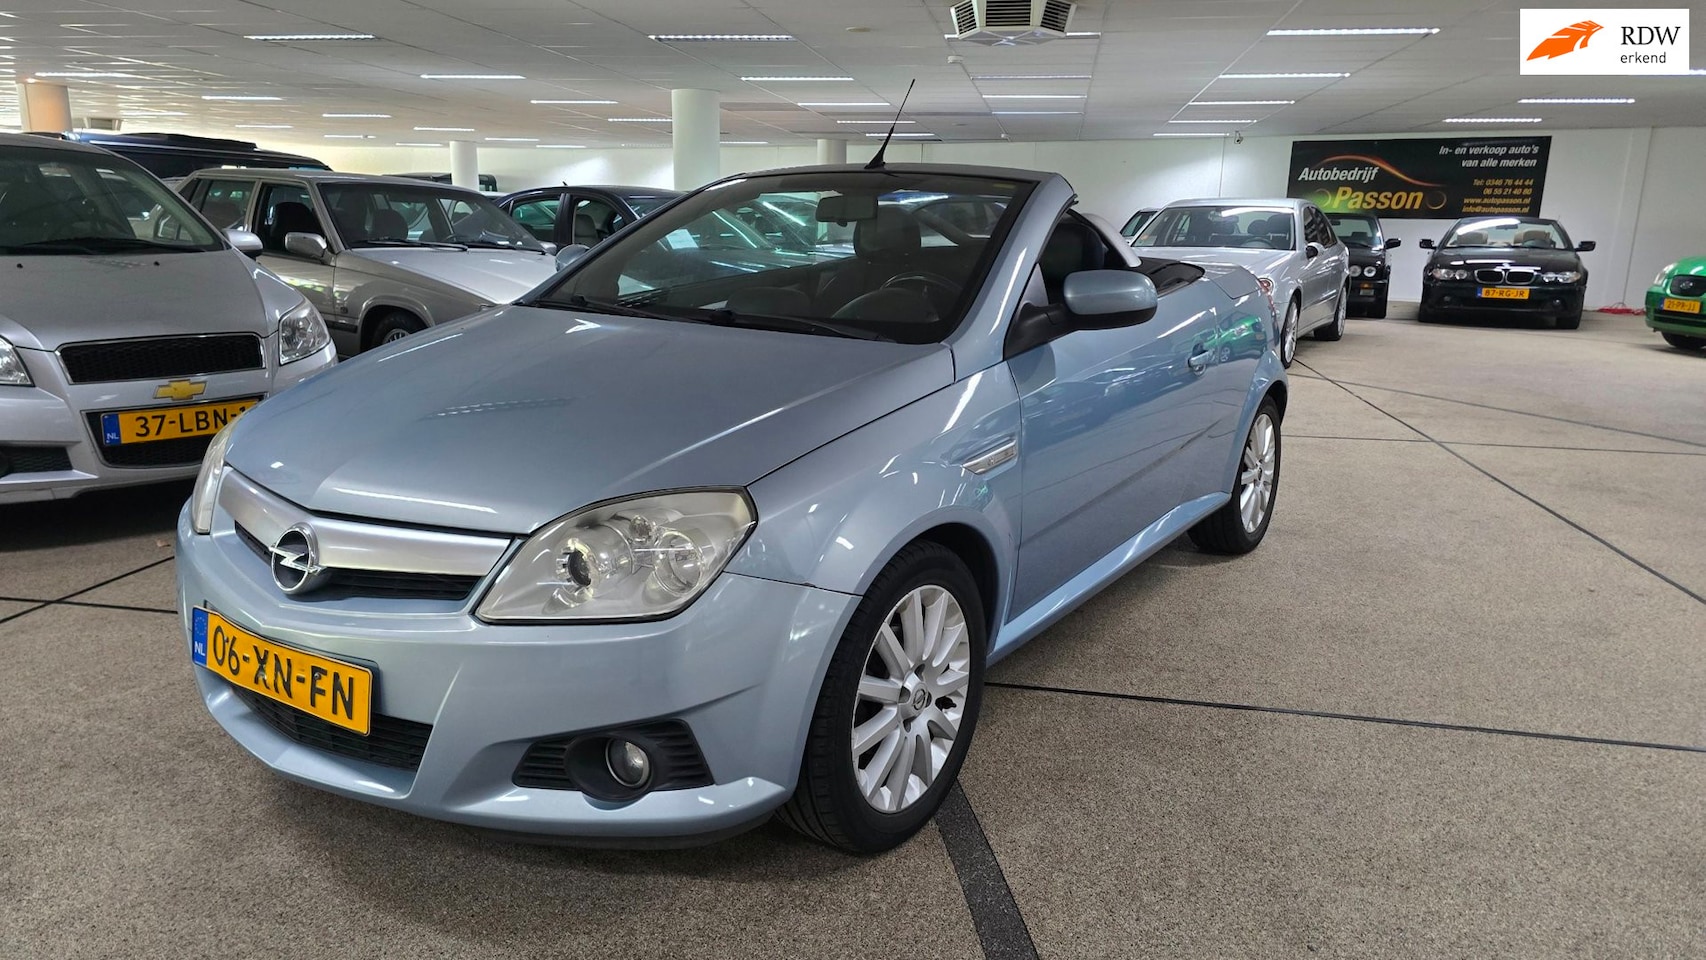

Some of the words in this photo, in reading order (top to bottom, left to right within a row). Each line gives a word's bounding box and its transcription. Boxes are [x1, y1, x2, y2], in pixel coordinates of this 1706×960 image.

[1439, 145, 1453, 155] In-
[1454, 147, 1467, 155] en
[1469, 145, 1507, 156] verkoop
[1508, 144, 1540, 154] auto's
[1461, 160, 1479, 168] van
[1480, 158, 1498, 167] alle
[1500, 158, 1538, 167] merken
[1298, 167, 1380, 184] Autobedrijf
[1514, 178, 1524, 186] 44
[1524, 178, 1534, 186] 44
[1333, 187, 1424, 210] Passon
[1463, 197, 1531, 205] www.autopasson.nl
[1462, 205, 1529, 214] info@autopasson.nl
[194, 641, 206, 657] NL
[213, 625, 354, 721] 06-XN-FN
